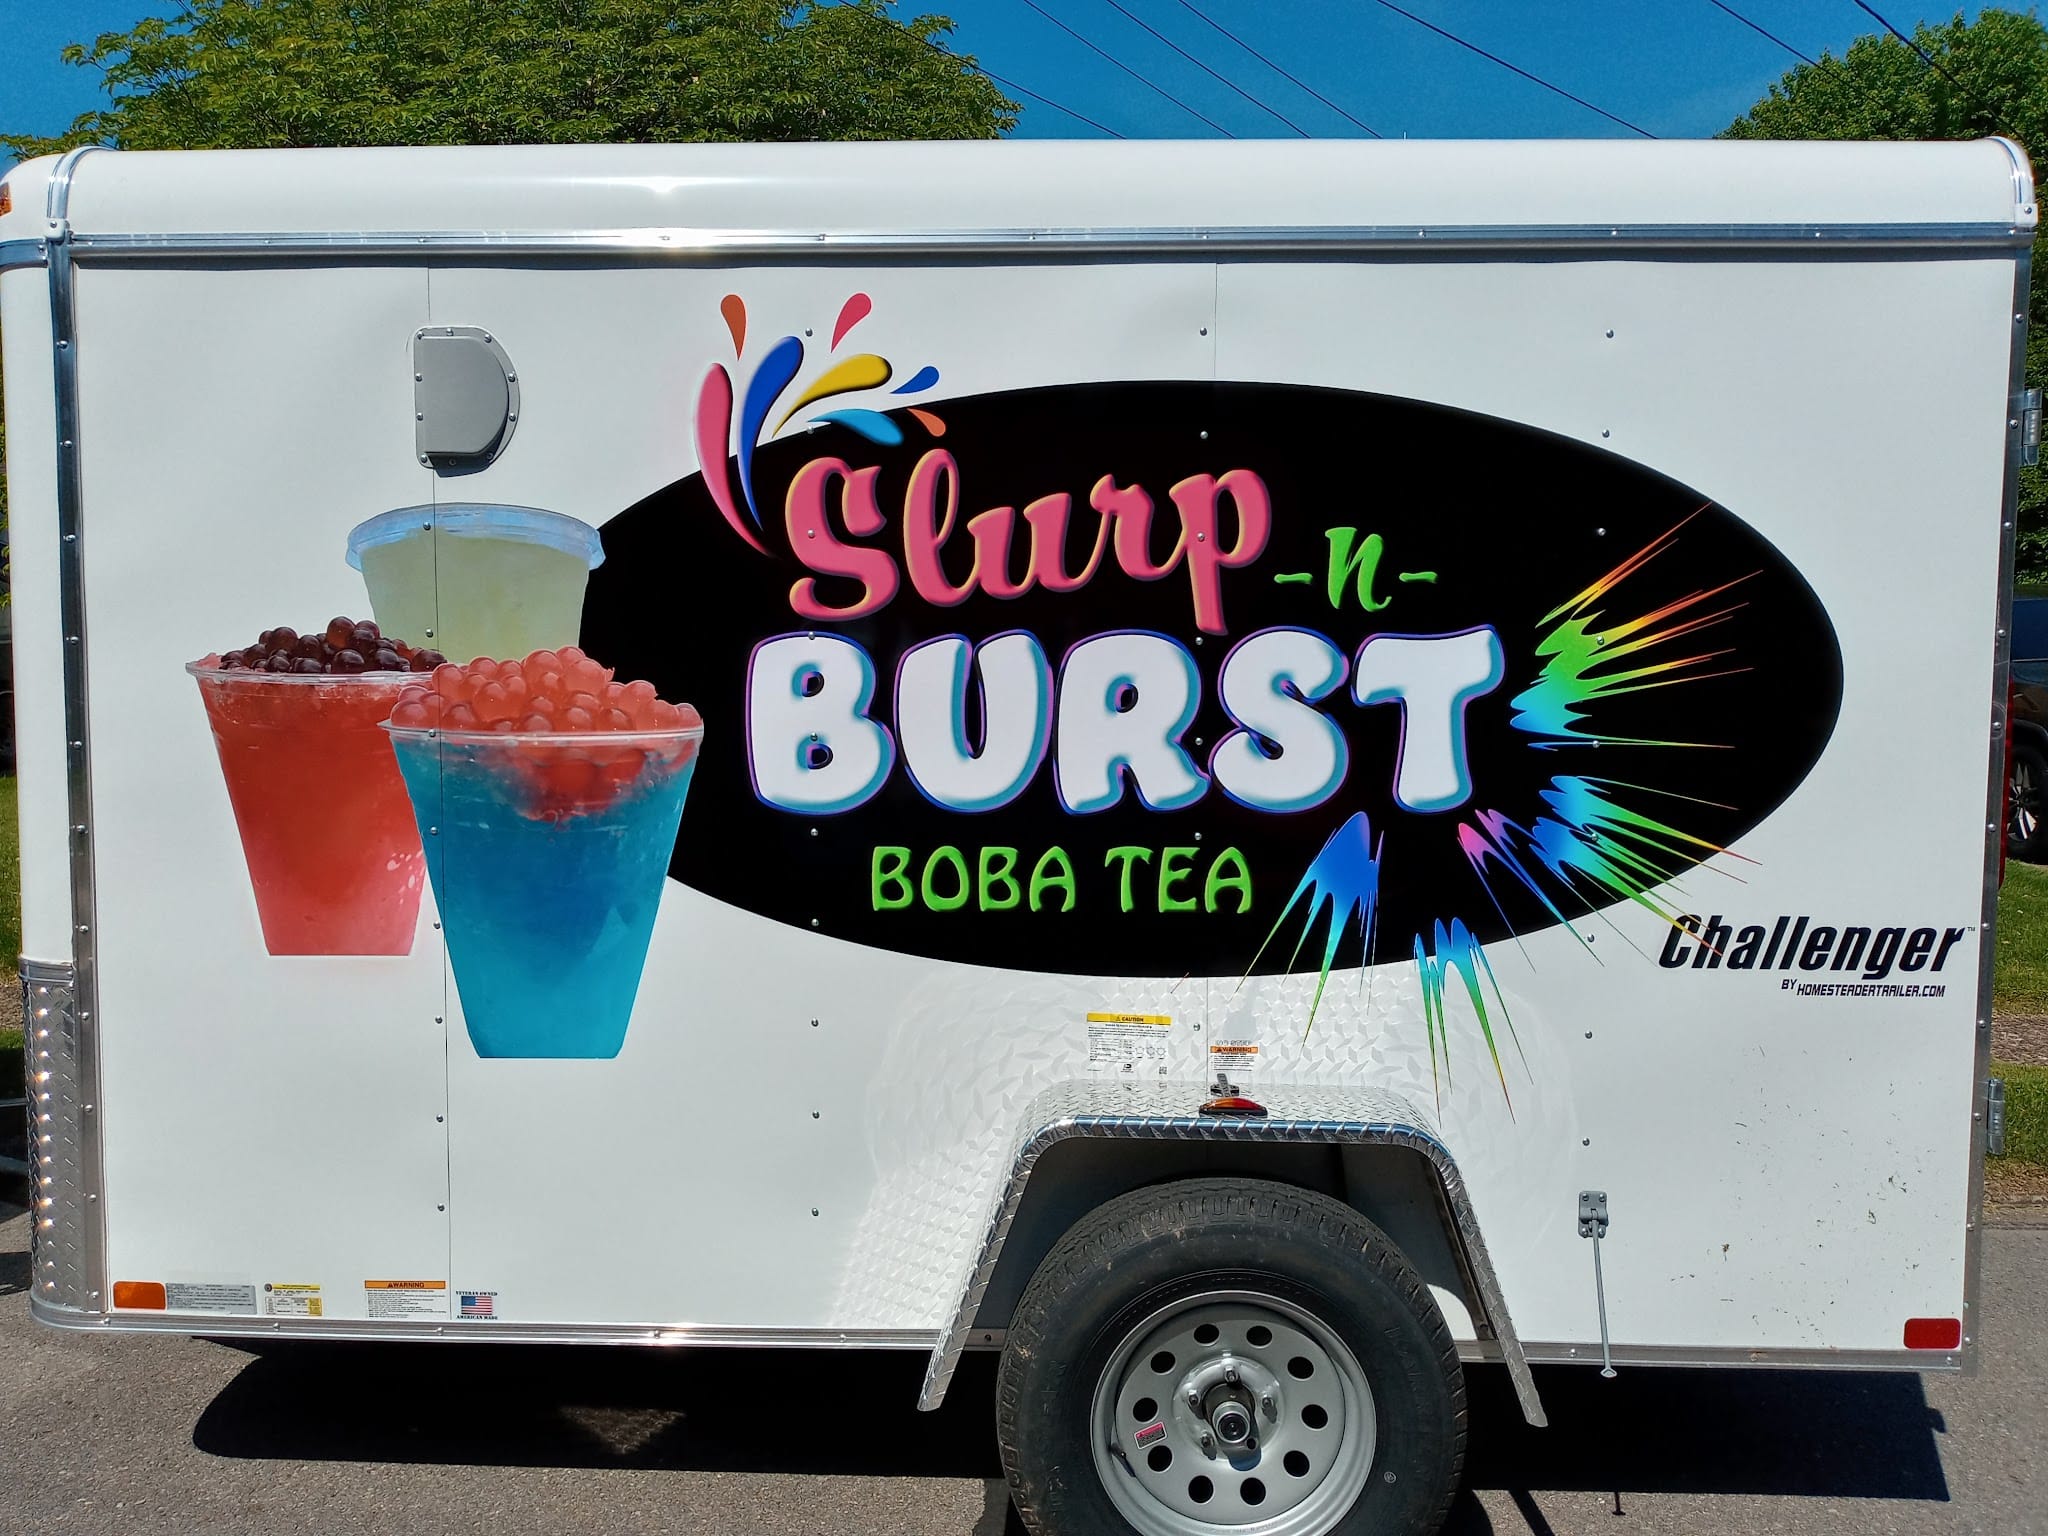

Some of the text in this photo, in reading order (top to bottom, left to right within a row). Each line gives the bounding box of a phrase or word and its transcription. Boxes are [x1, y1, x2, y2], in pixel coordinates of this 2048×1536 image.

[784, 448, 1272, 635] Slurp
[745, 625, 1507, 815] BURST
[871, 845, 1254, 914] BOBA TEA
[1658, 914, 1966, 981] Challenger
[1781, 979, 1946, 998] BY HOMESTEADERTRAILER.COM
